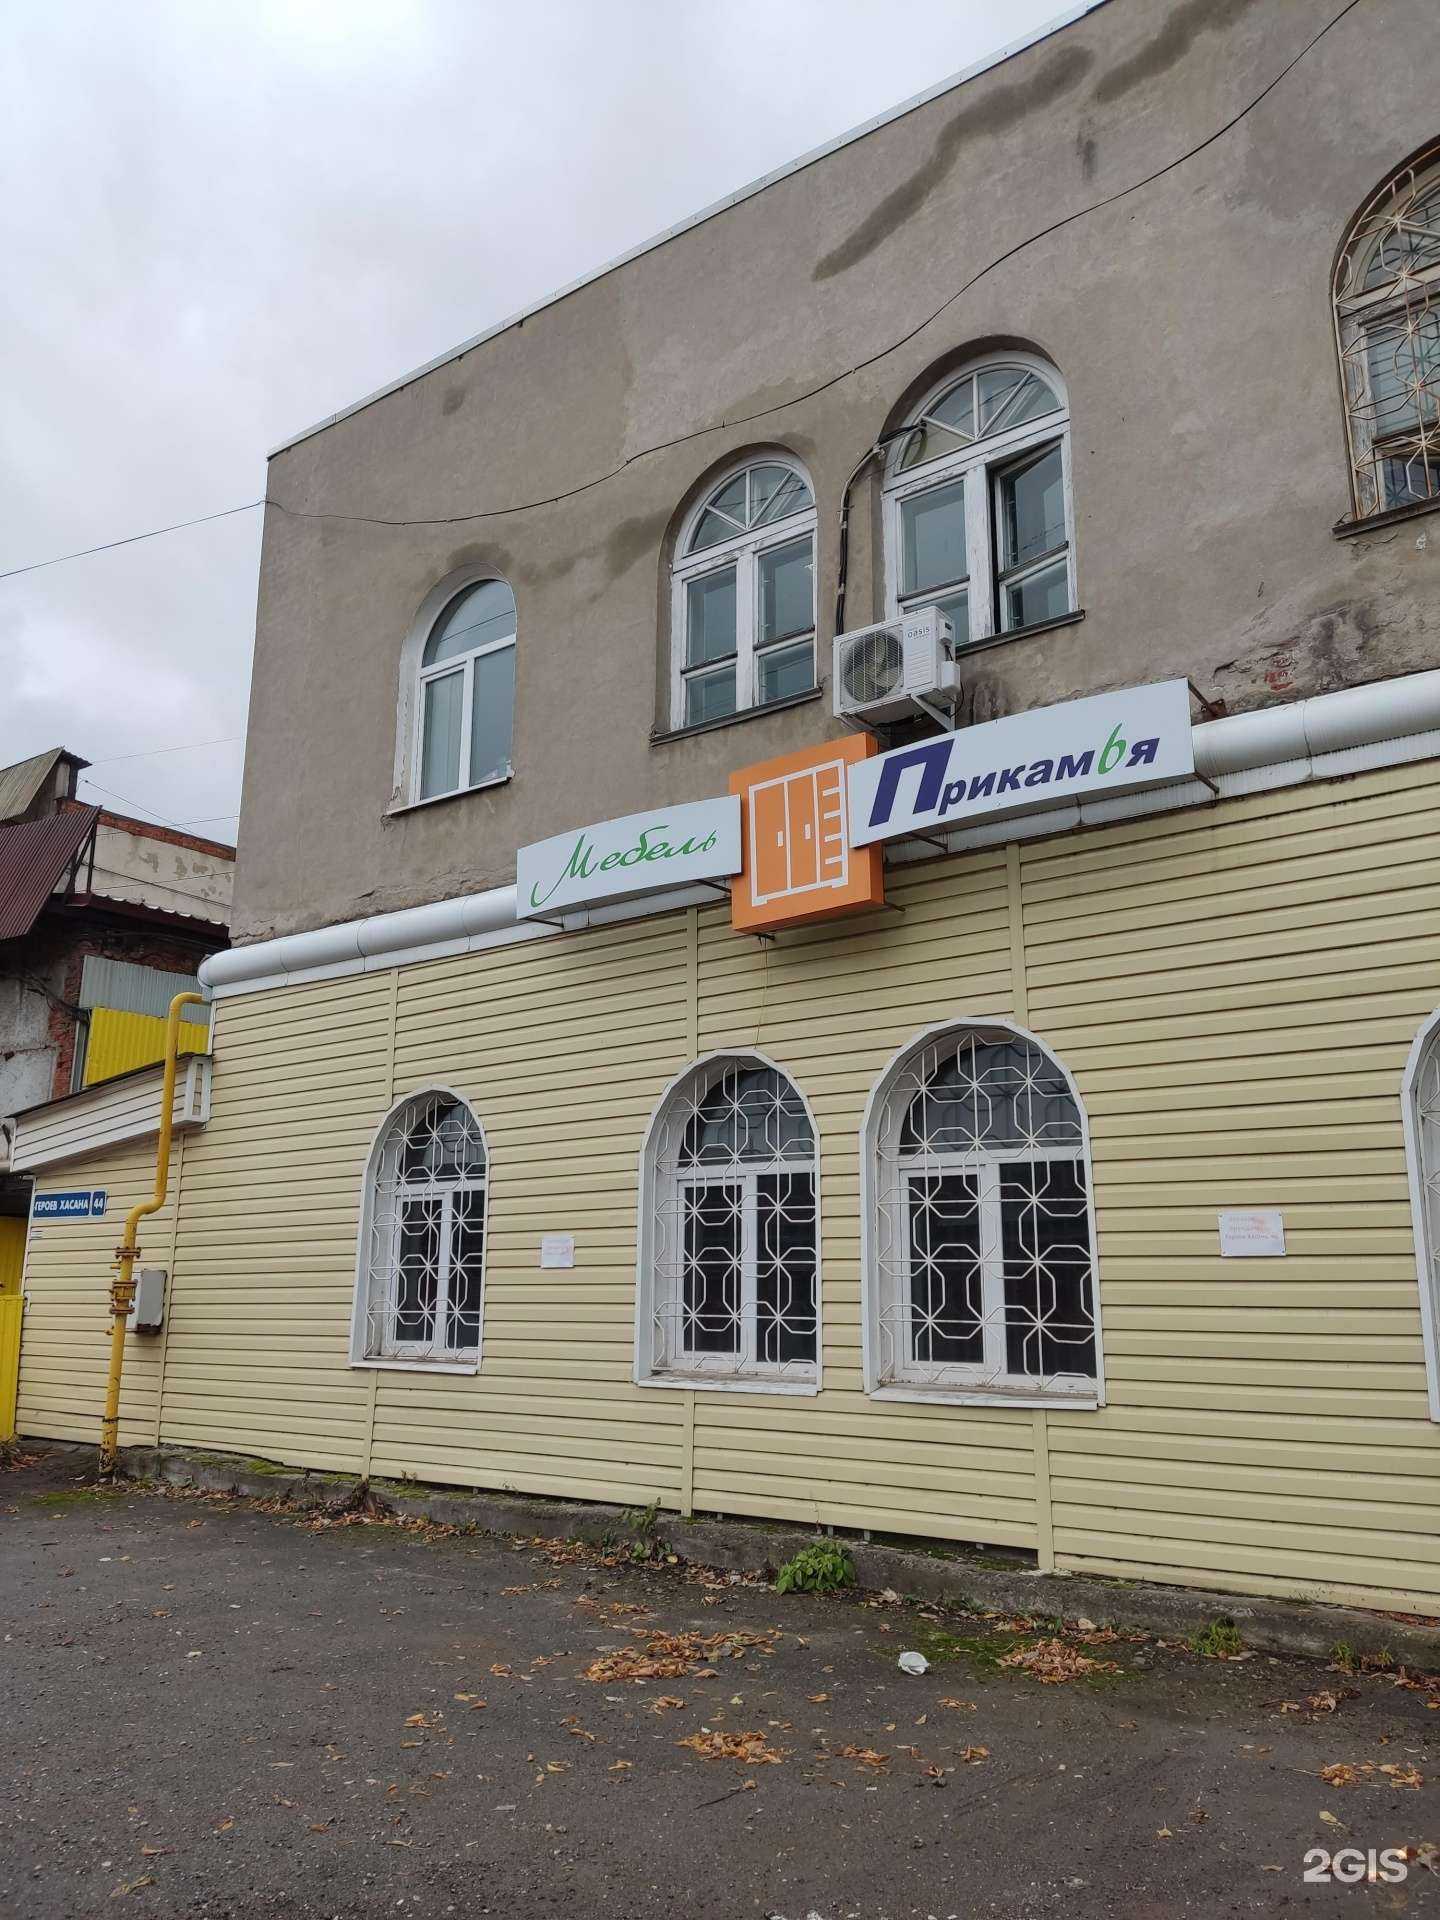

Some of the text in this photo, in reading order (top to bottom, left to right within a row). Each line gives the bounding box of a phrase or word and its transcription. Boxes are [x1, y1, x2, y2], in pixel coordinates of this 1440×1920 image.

[907, 625, 930, 638] oasis
[868, 722, 1160, 827] Прикамья
[530, 825, 717, 908] Мебель
[34, 1198, 104, 1211] ГЕРОЕВ ХАСАНА 44
